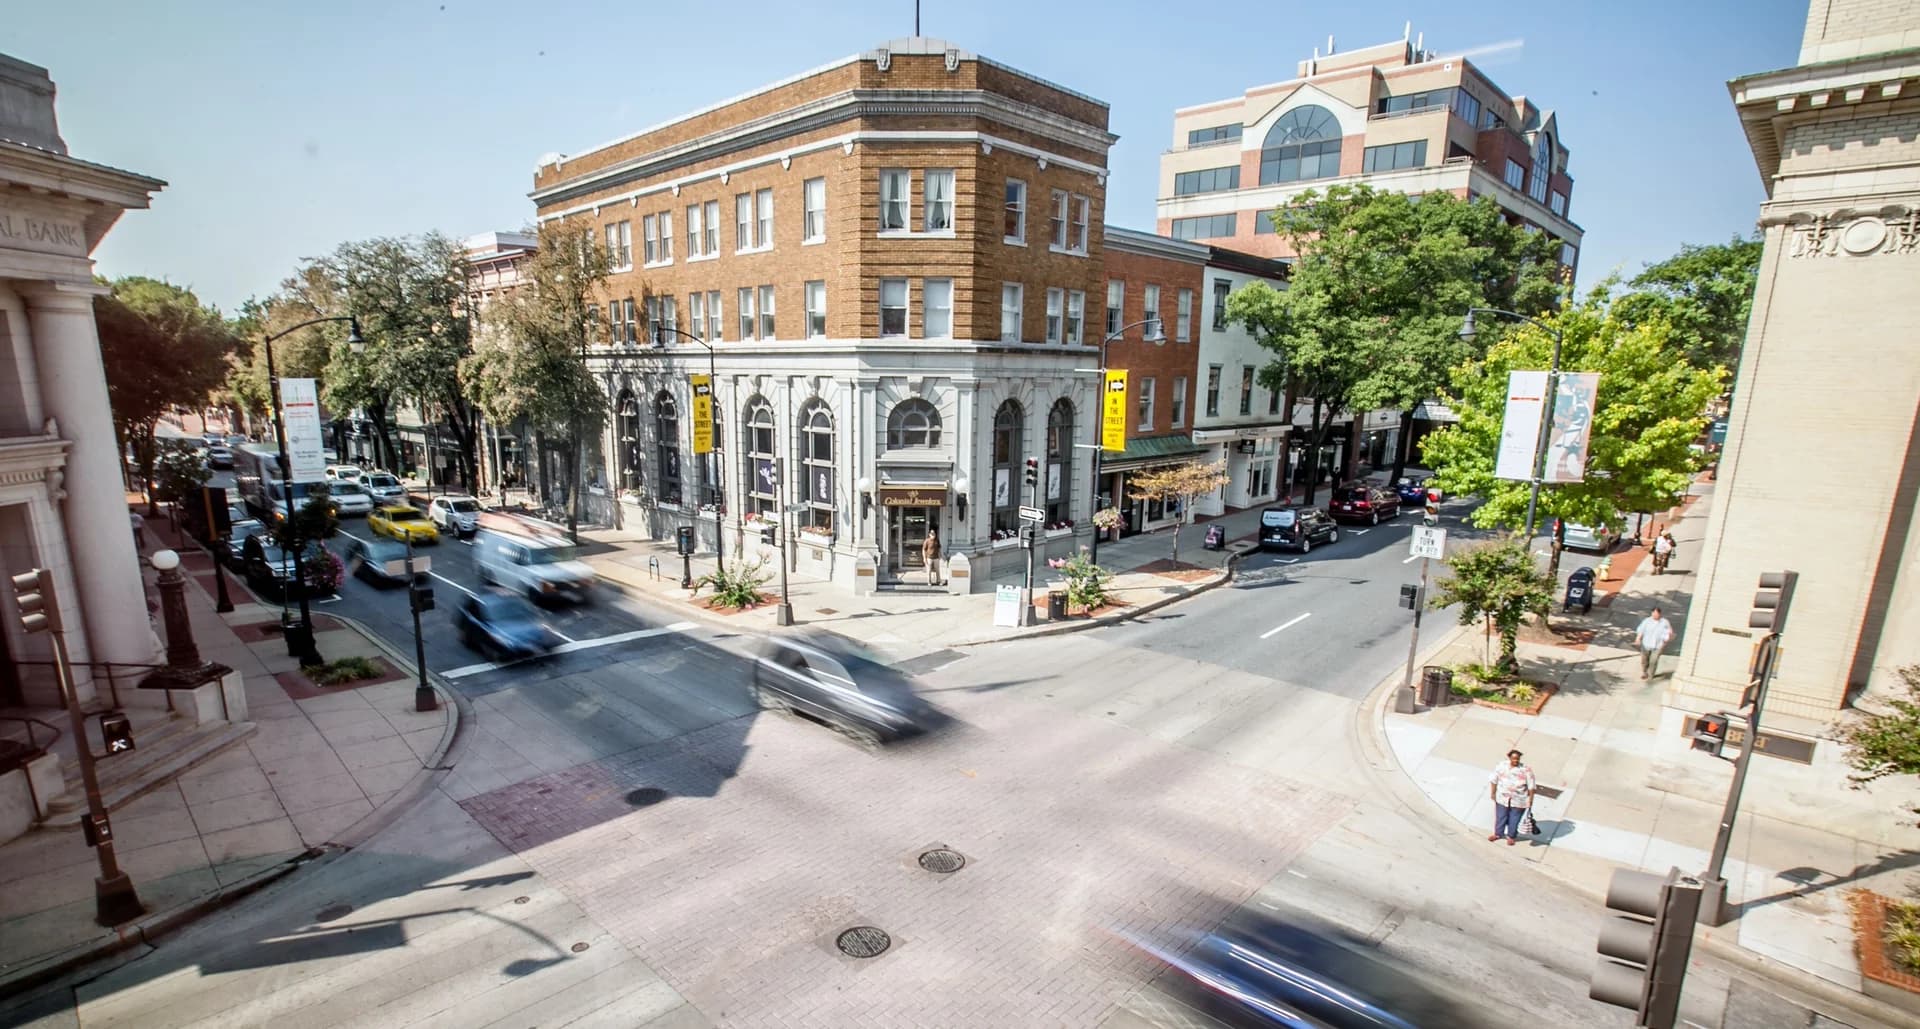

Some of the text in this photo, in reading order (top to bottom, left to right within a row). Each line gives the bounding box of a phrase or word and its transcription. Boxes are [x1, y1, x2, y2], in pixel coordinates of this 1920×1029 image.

[24, 217, 80, 248] BANK
[1110, 407, 1119, 415] THE
[695, 420, 711, 428] STREET
[1105, 416, 1123, 425] STREET
[1425, 529, 1433, 538] NO
[1420, 536, 1434, 546] TURN
[1414, 544, 1438, 556] ON RED
